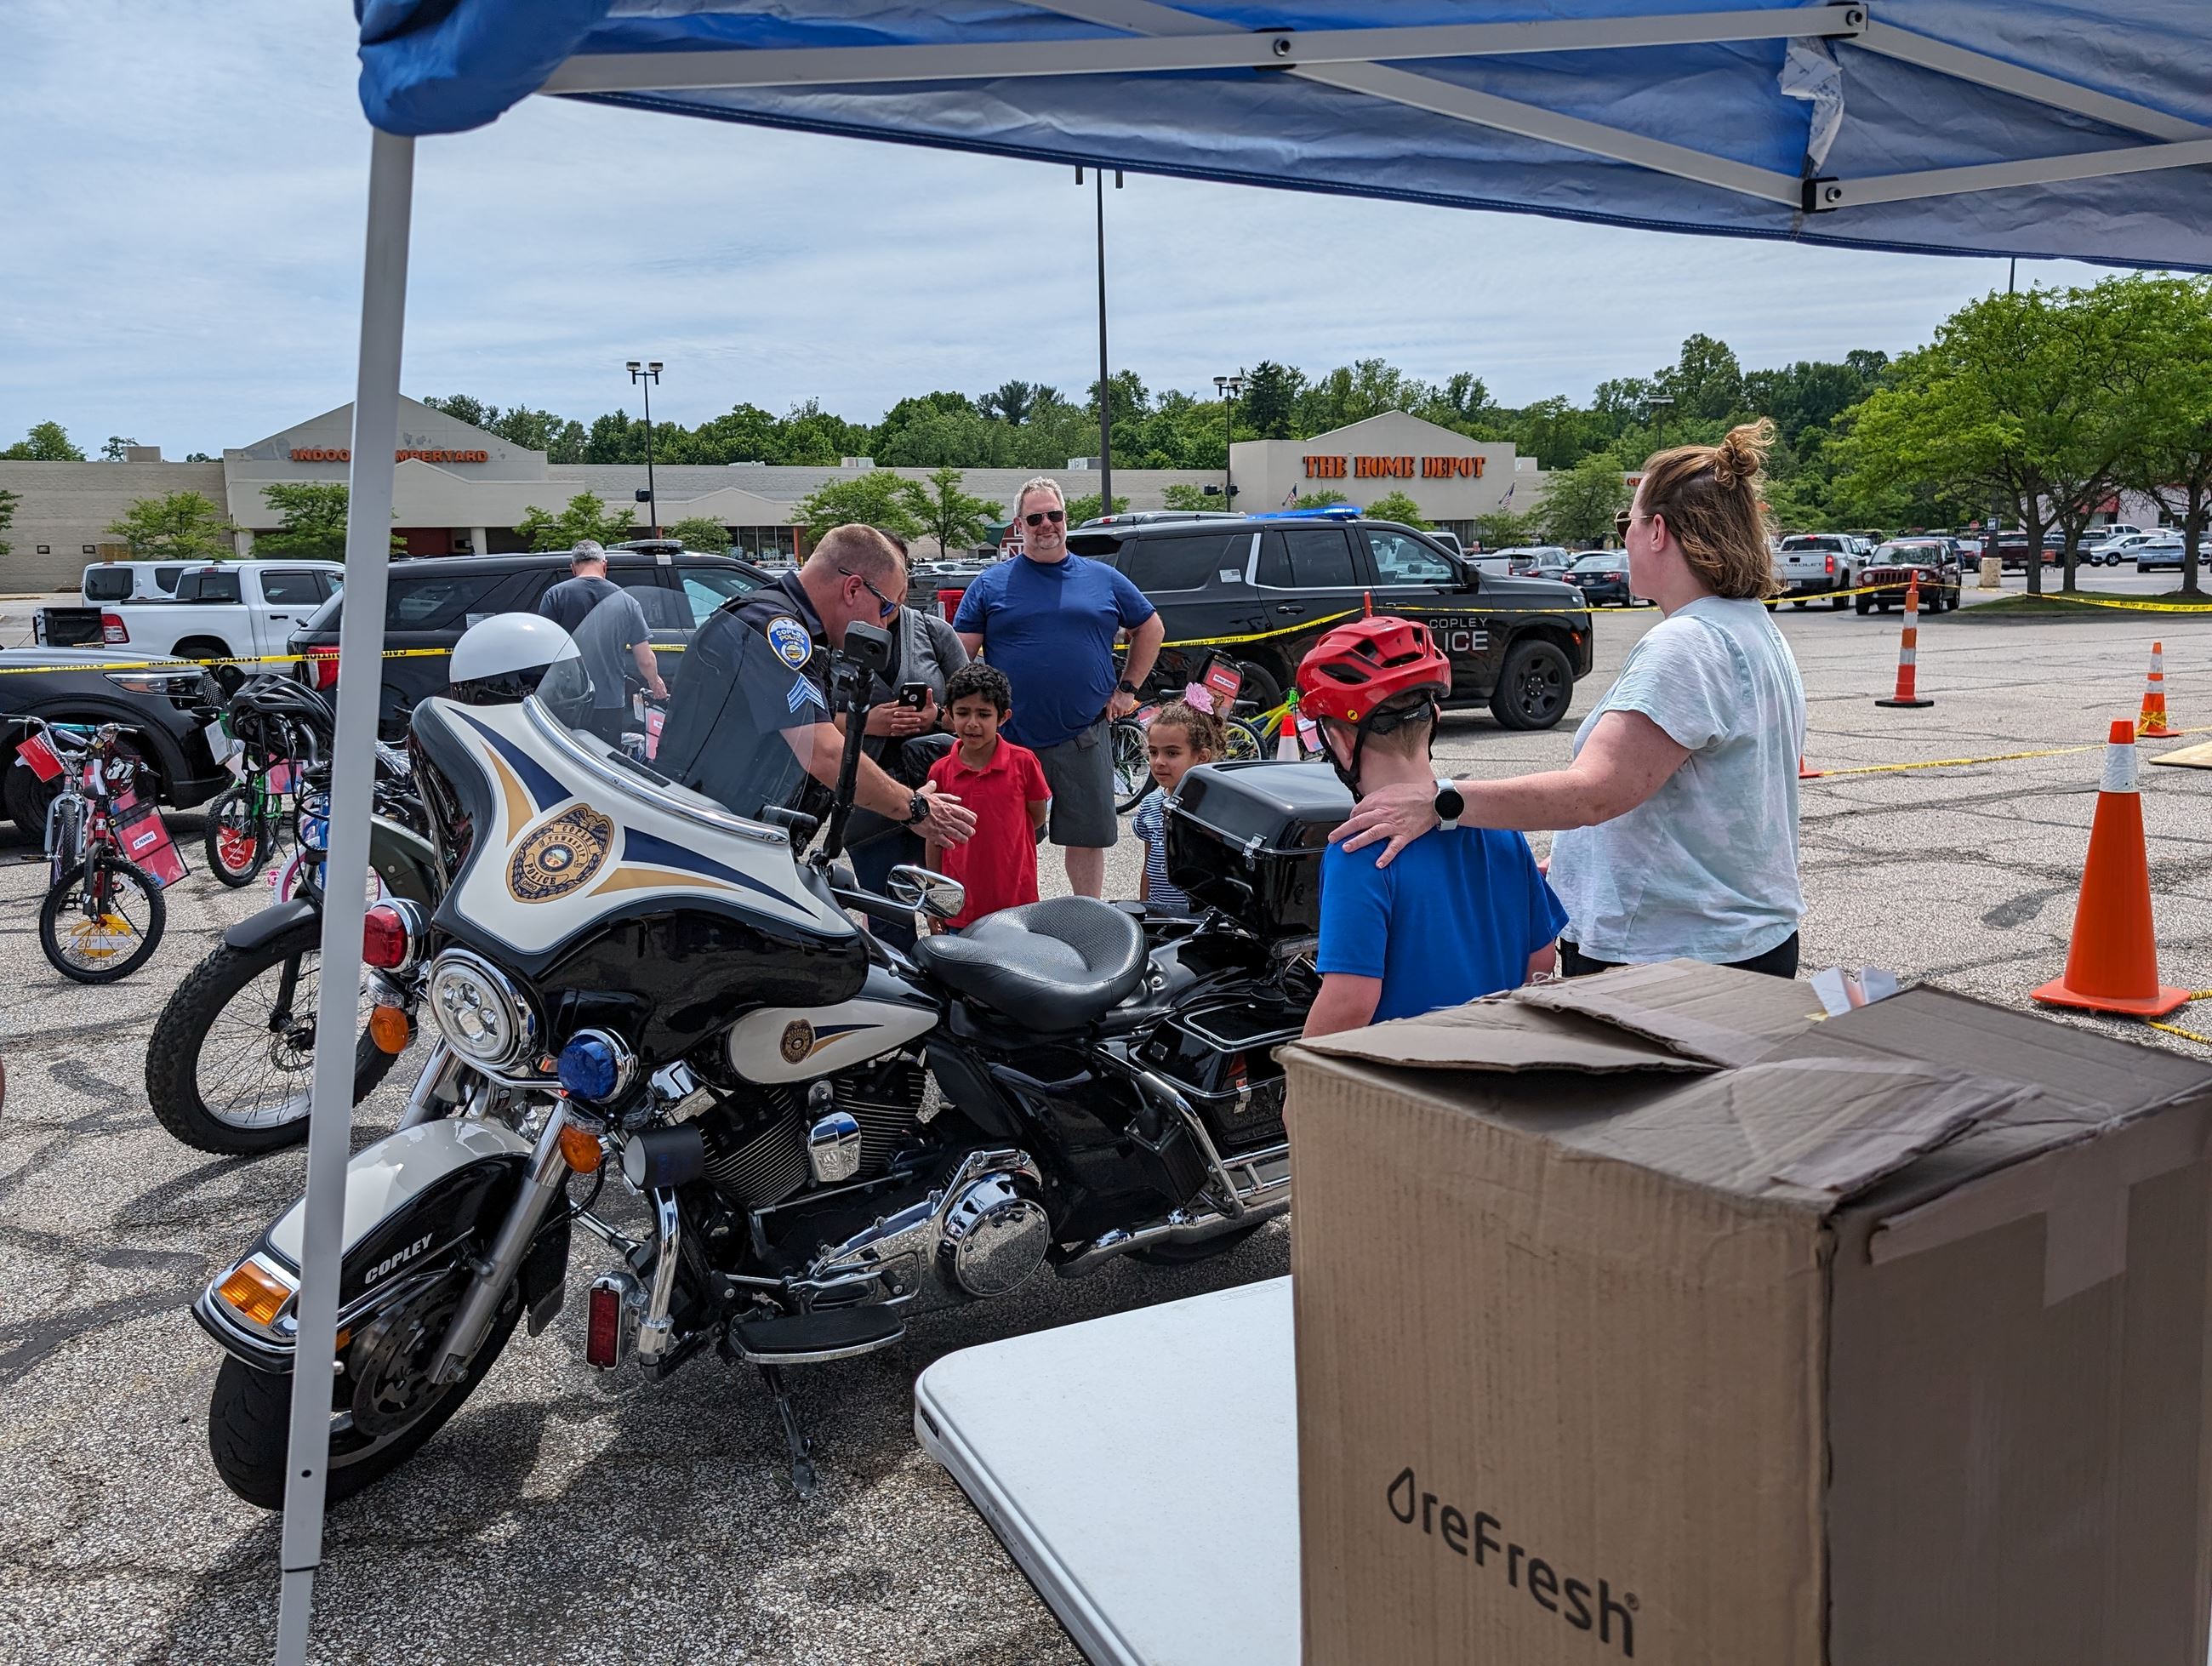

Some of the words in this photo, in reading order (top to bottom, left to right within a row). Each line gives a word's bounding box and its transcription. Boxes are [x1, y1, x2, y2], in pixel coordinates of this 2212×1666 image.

[291, 448, 351, 462] INDOO
[396, 449, 488, 463] MBERYARD
[1303, 456, 1348, 477] THE
[1354, 456, 1415, 477] HOME
[1422, 457, 1485, 478] DEPOT
[1429, 618, 1488, 629] COPLEY
[776, 629, 806, 640] COPLEY
[778, 634, 805, 645] POLICE
[1445, 630, 1489, 652] ICE
[548, 836, 586, 857] TOWNSHIP
[562, 825, 597, 847] COPLEY
[524, 862, 557, 886] POLICE
[522, 880, 539, 891] OHIO
[364, 1233, 433, 1285] COPLEY
[1422, 1491, 1634, 1658] reFresh
